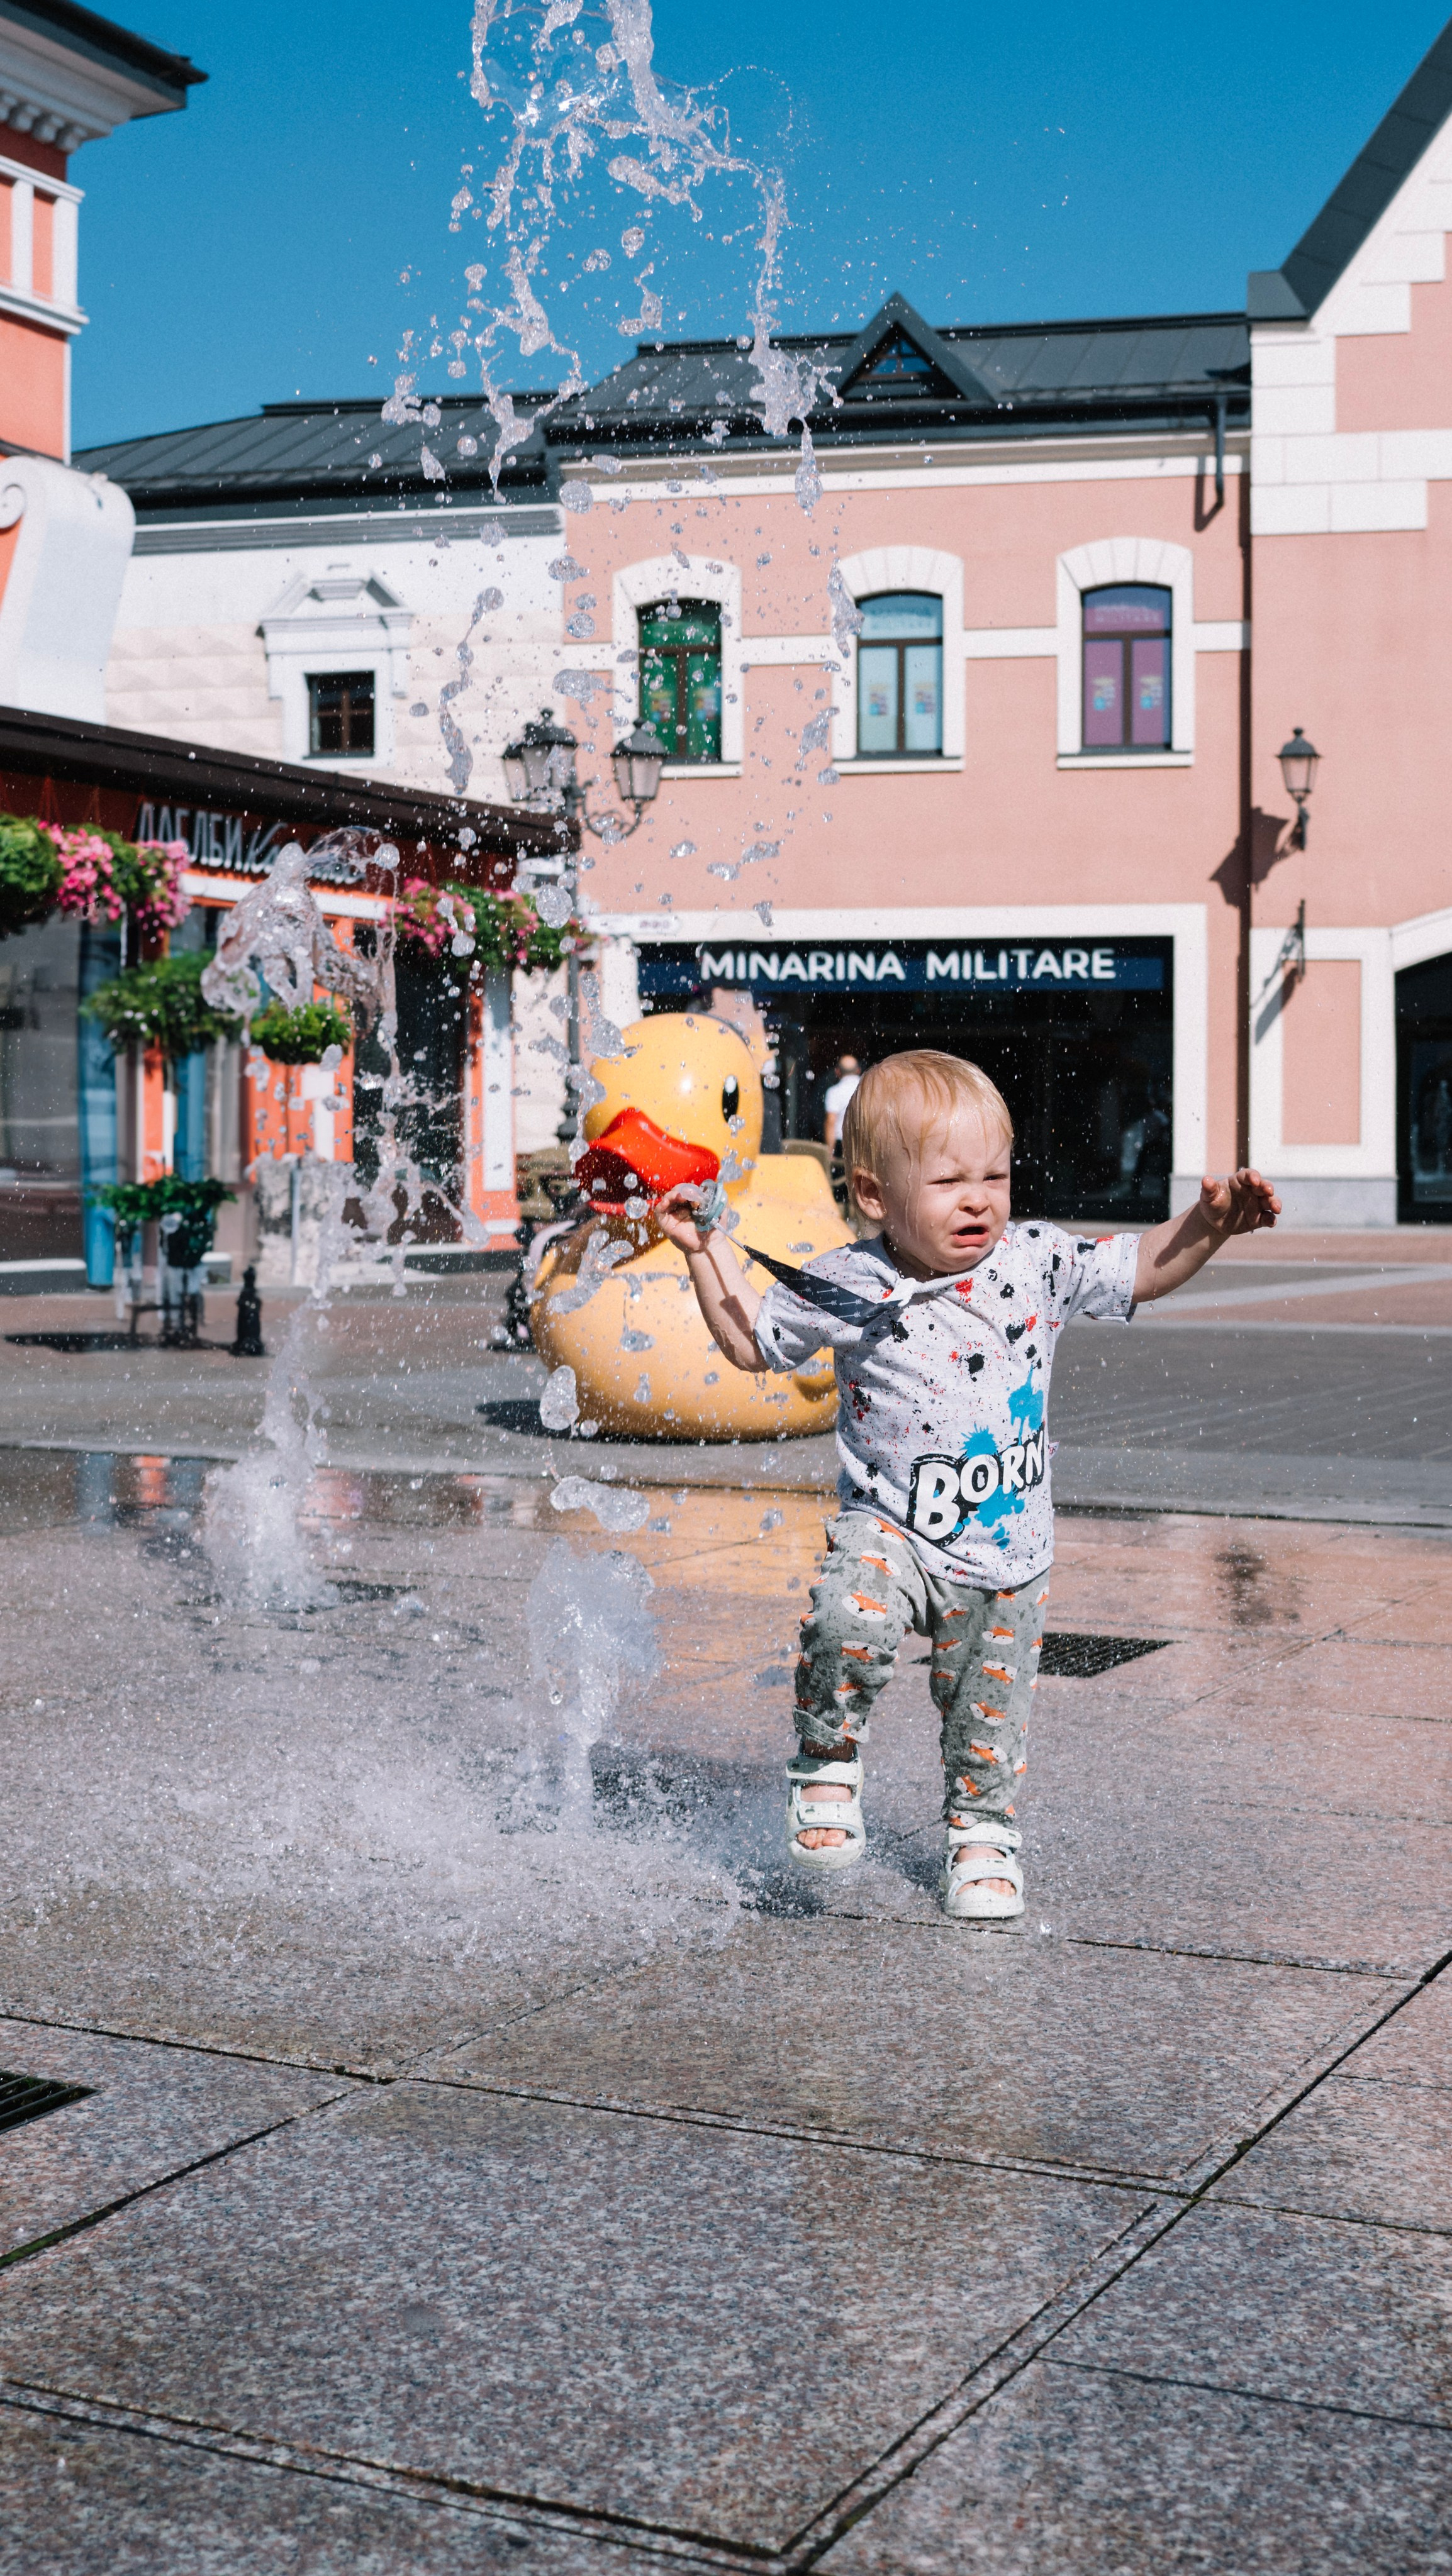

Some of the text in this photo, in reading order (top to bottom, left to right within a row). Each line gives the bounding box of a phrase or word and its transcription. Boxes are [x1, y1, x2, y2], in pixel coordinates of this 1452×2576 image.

[700, 948, 1117, 982] MINARINA MILITARE
[912, 1429, 1045, 1541] BORN
